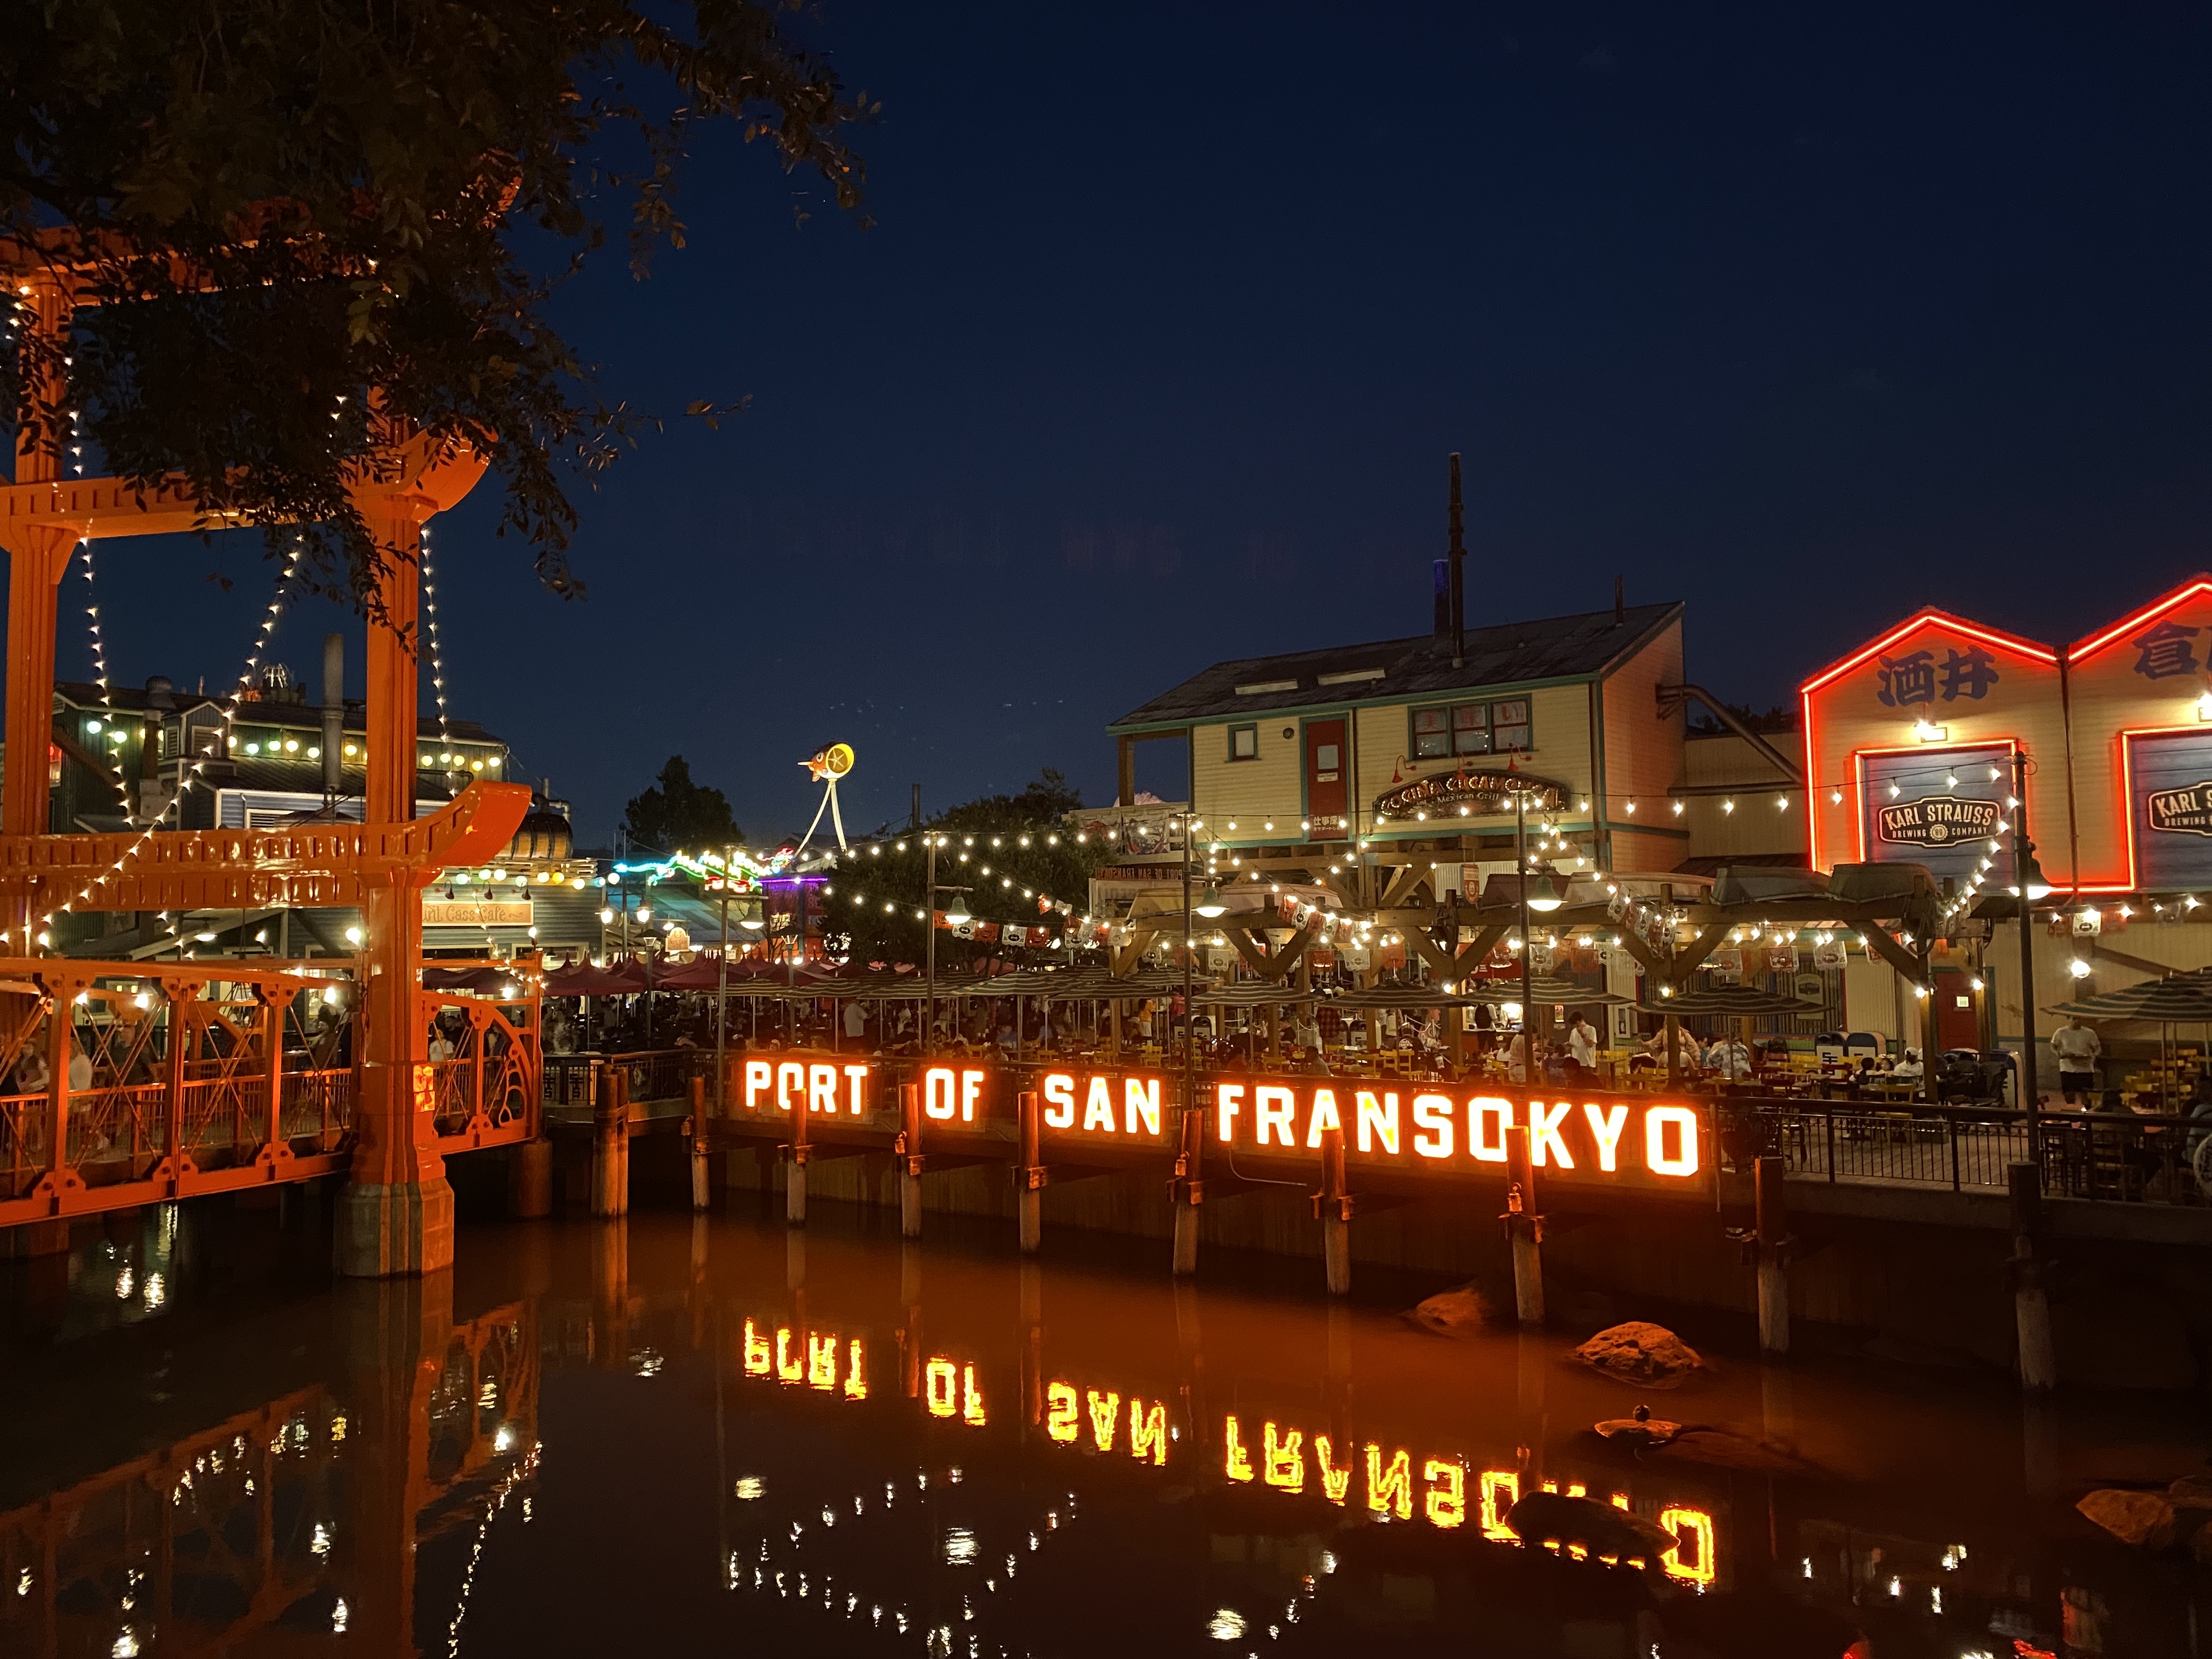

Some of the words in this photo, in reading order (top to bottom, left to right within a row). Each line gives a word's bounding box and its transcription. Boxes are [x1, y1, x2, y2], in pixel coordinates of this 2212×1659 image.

[2132, 619, 2212, 680] 倉
[1877, 645, 1999, 707] 酒井
[1381, 779, 1446, 816] COCINA
[1436, 793, 1475, 803] Mexican
[1477, 792, 1499, 800] Grill
[2155, 792, 2201, 818] KARL
[1885, 806, 1922, 830] KARL
[1927, 804, 1994, 826] STRAUSS
[2164, 816, 2206, 826] BREWING
[1893, 829, 1927, 838] BREWING
[1951, 826, 1988, 836] COMPANY
[422, 905, 443, 923] unt
[445, 905, 475, 922] Cass
[746, 1061, 868, 1115] PORT
[926, 1068, 984, 1122] OF
[1045, 1074, 1160, 1135] SAN
[1218, 1084, 1699, 1177] FRANSOKYO
